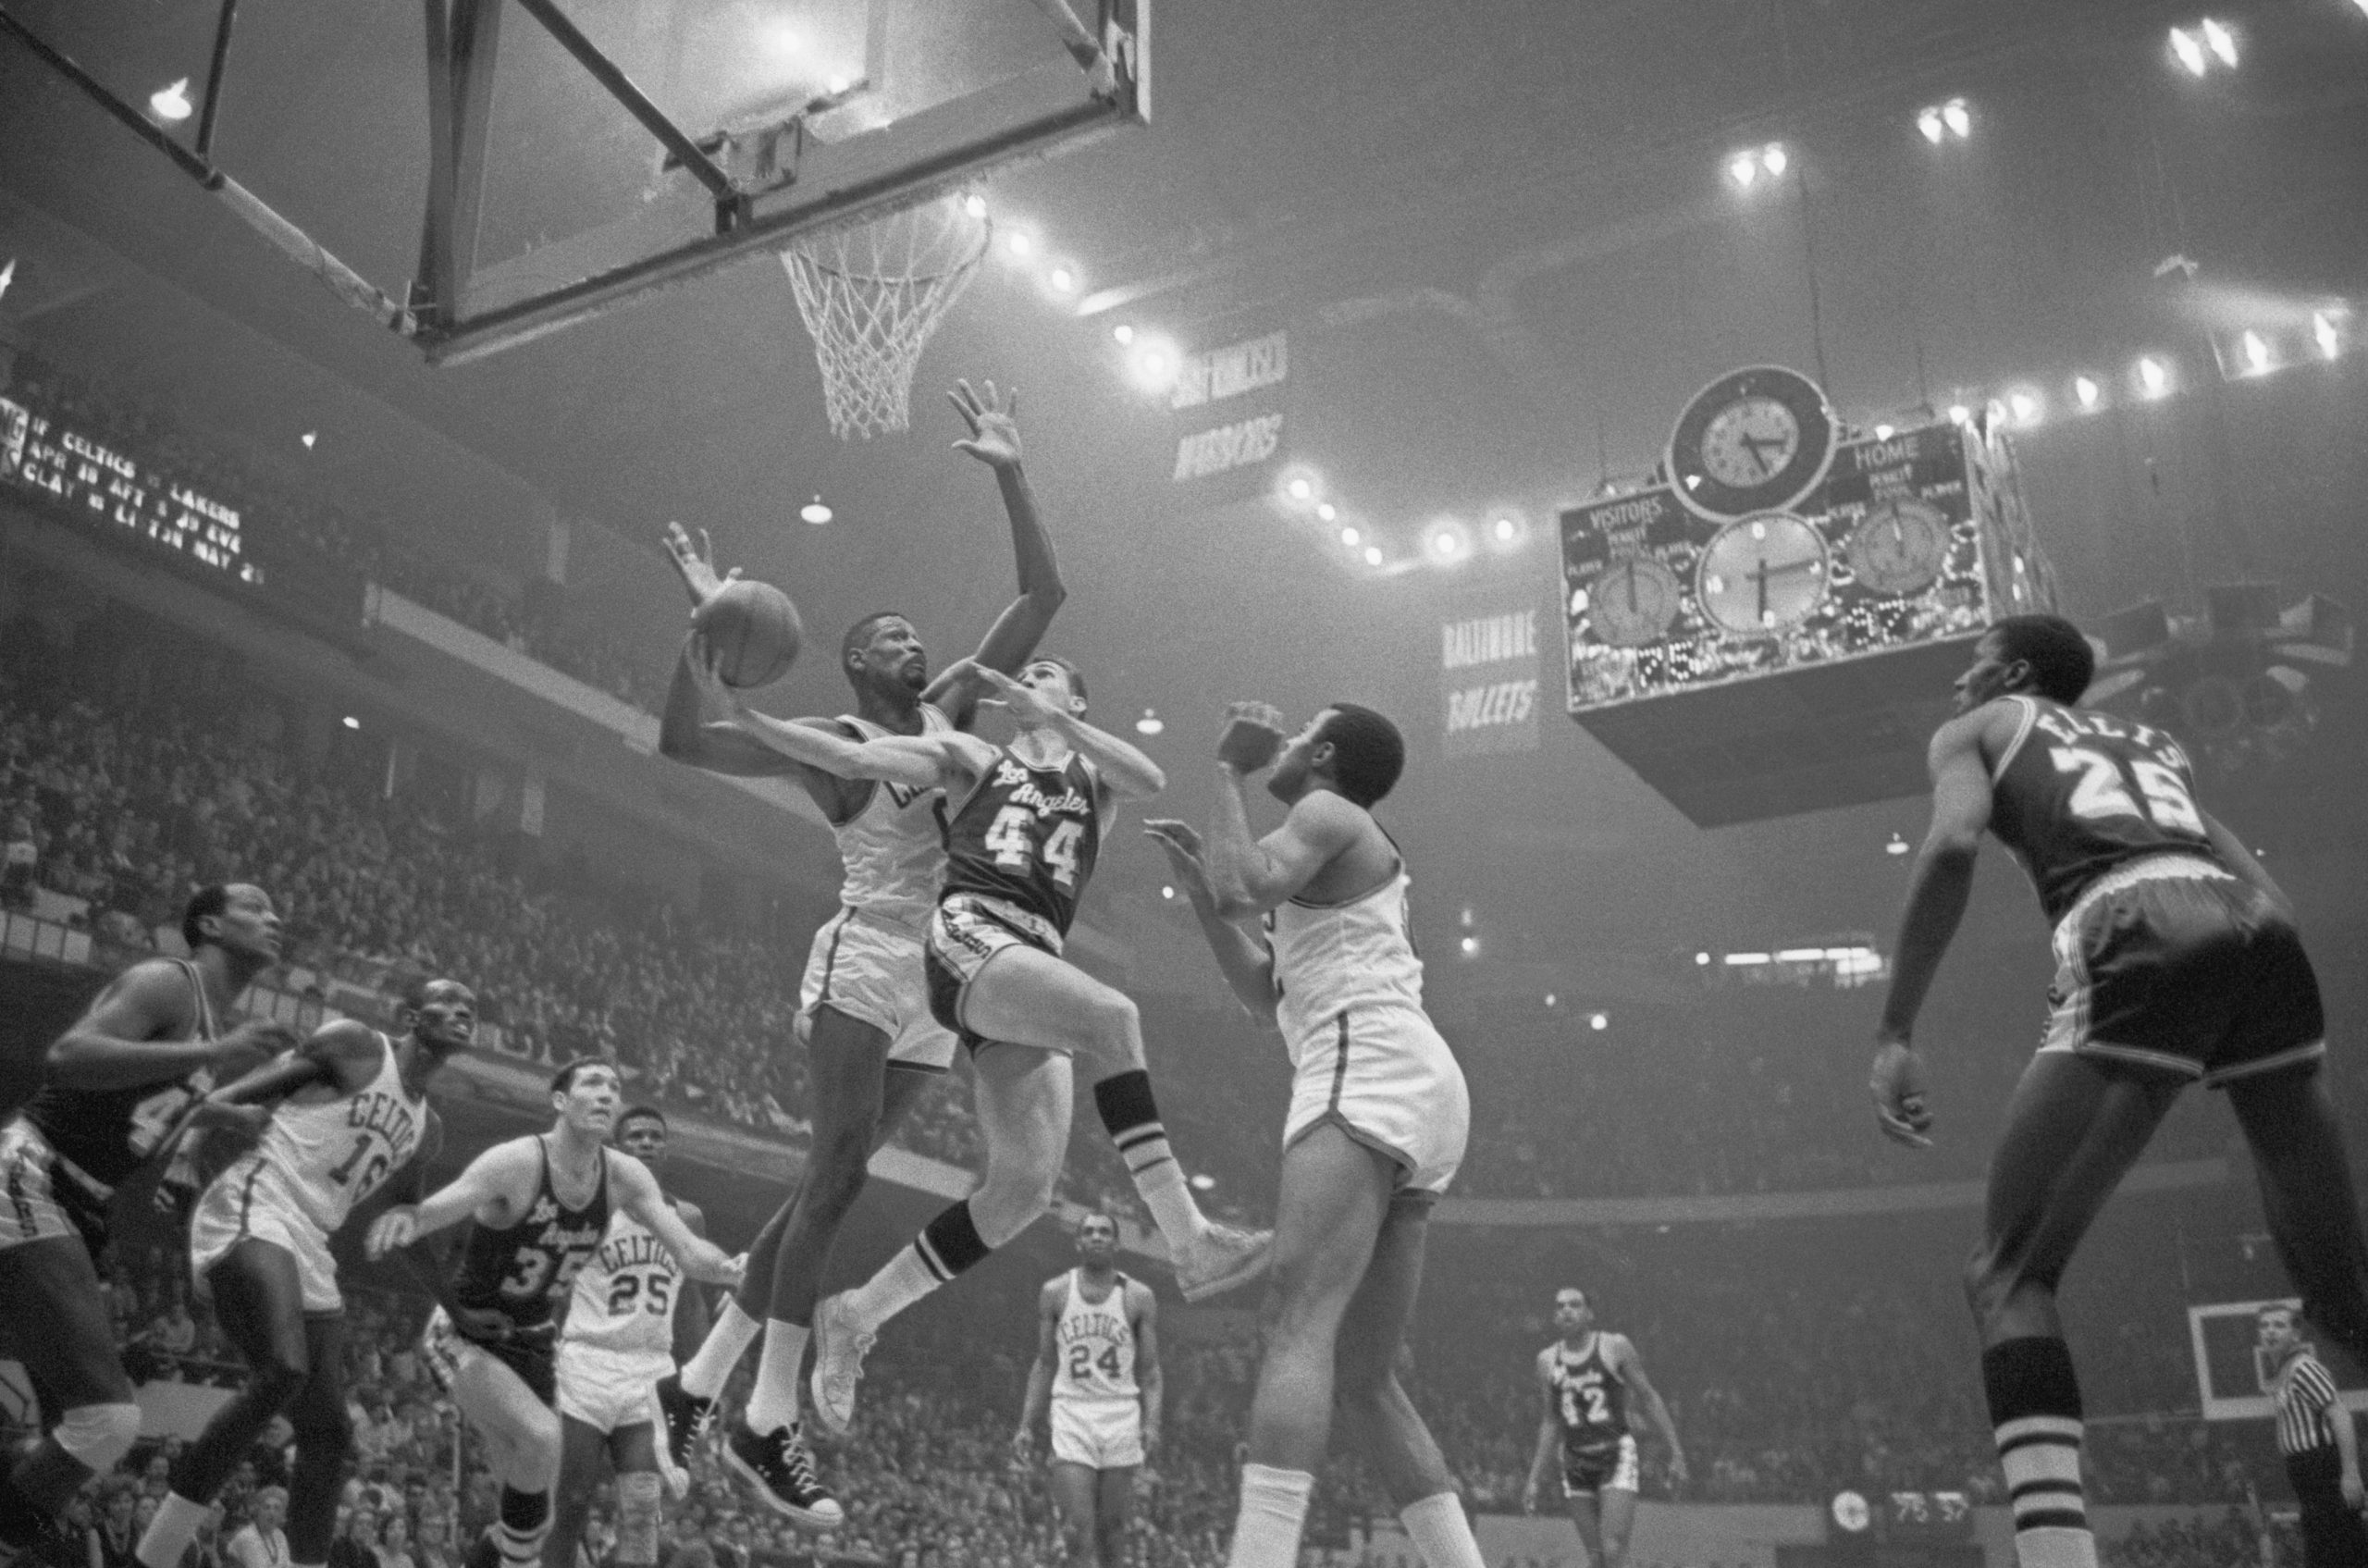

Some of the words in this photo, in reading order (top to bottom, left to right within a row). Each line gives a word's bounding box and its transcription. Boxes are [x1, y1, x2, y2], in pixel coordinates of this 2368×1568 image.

[62, 431, 135, 479] CELTICS
[1855, 436, 1919, 470] HOME
[23, 463, 74, 498] CLAY
[1589, 497, 1663, 531] VISITORS
[2036, 707, 2186, 770] ELLIS
[992, 759, 1029, 787] Los
[1008, 783, 1090, 818] Angeles
[2049, 747, 2206, 836] 25
[984, 804, 1084, 888] 44
[608, 1274, 671, 1317] 25
[1062, 1314, 1129, 1347] CELTICS
[1069, 1344, 1120, 1378] 24
[1561, 1389, 1610, 1425] 12
